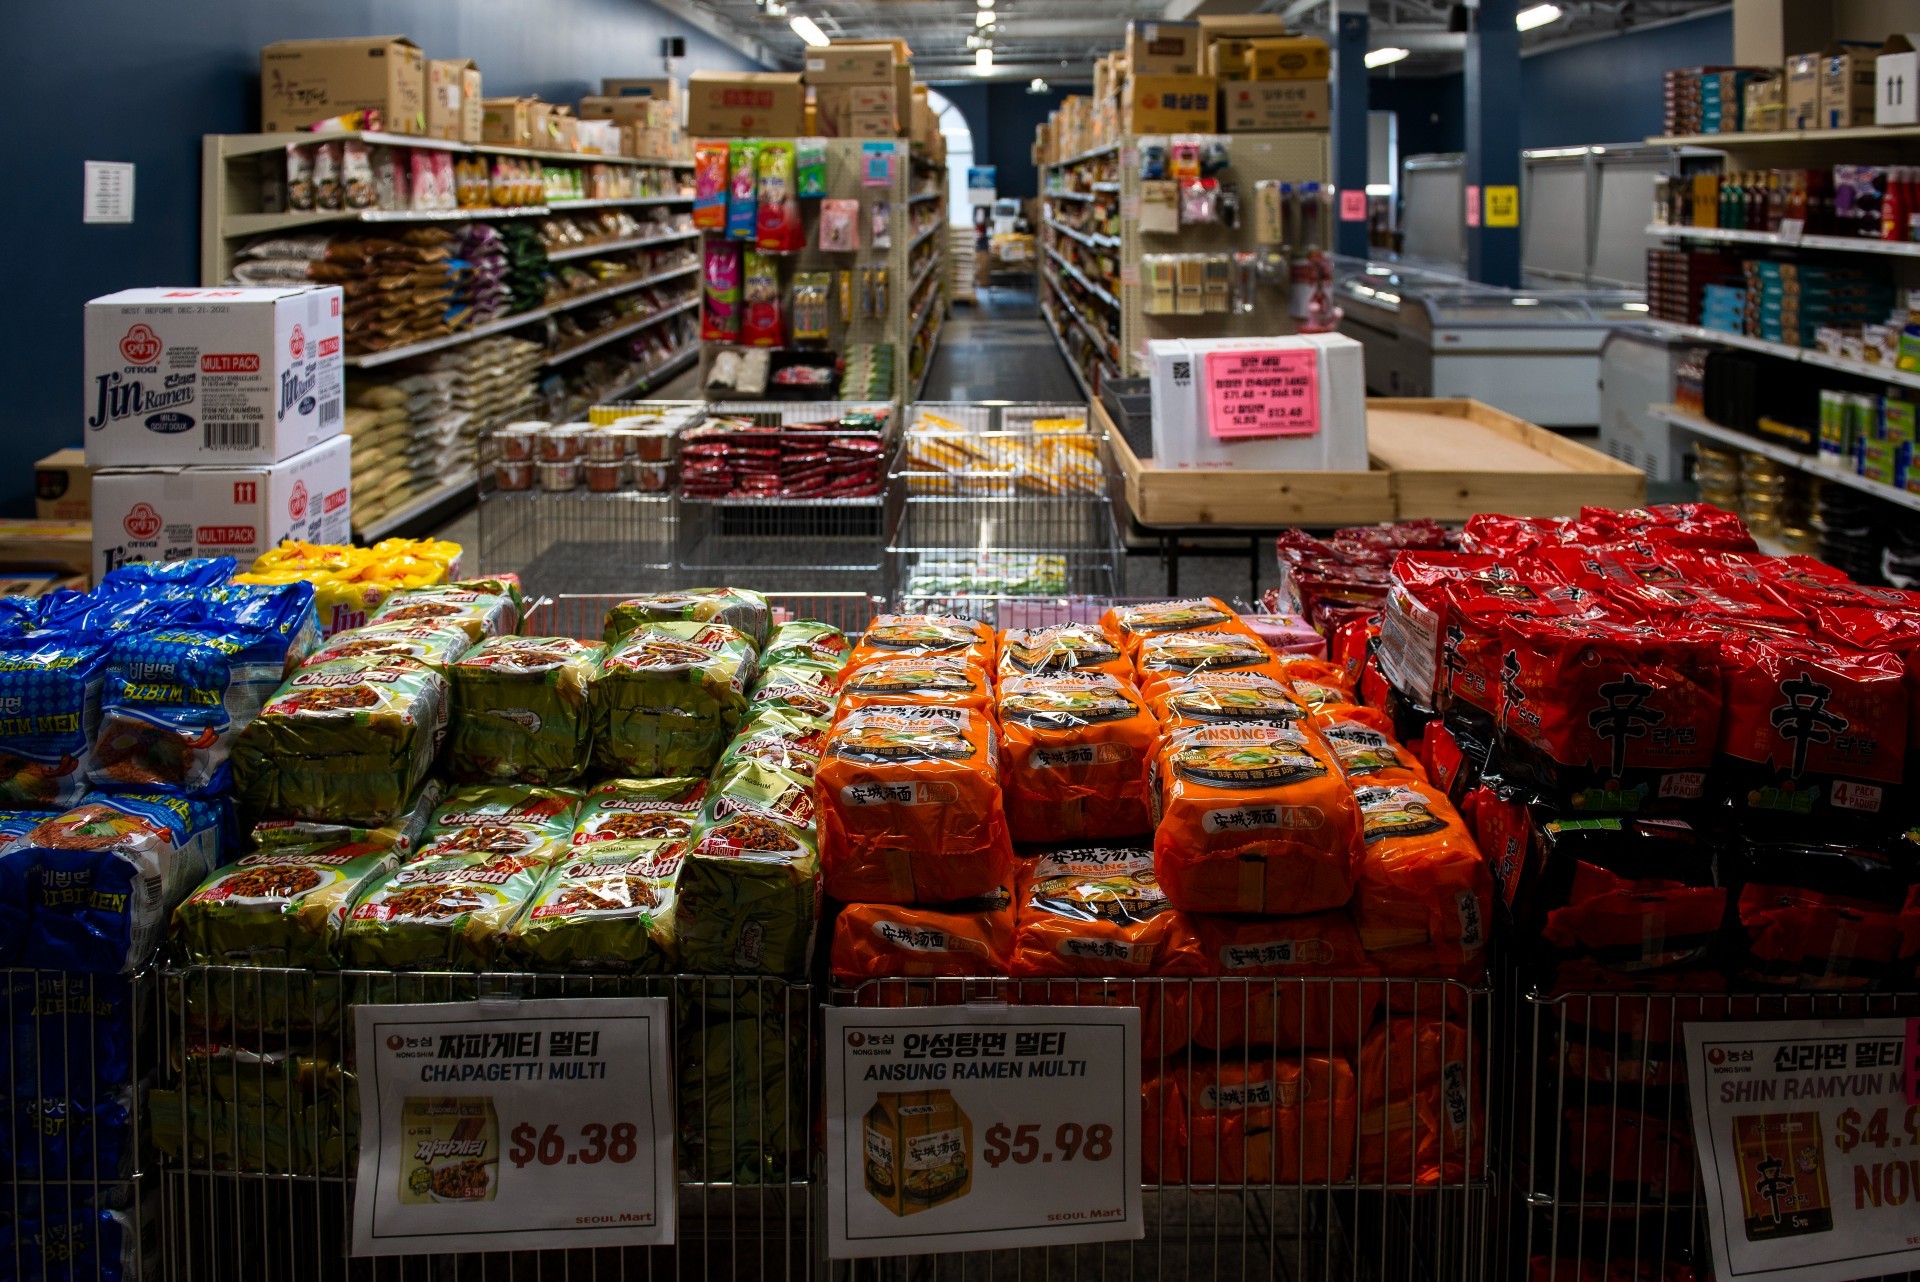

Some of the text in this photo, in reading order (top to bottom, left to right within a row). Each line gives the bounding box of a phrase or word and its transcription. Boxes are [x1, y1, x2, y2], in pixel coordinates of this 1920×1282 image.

[121, 306, 140, 315] BEST
[145, 306, 174, 314] BEFORE
[124, 366, 157, 374] OTTOGI
[202, 356, 230, 370] MULTI
[232, 356, 258, 370] PACK
[88, 371, 143, 430] Jin
[144, 387, 193, 411] Ramen
[278, 366, 298, 421] Jin
[198, 529, 226, 543] MULTI
[229, 529, 255, 542] PACK
[129, 662, 177, 681] 비빔면
[123, 682, 184, 703] BIBIM
[37, 711, 80, 733] MEN
[862, 715, 932, 726] ANSUNG
[1588, 672, 1667, 779] 辛
[1770, 671, 1850, 780] 辛
[1195, 728, 1266, 741] ANSUNG
[1651, 726, 1697, 746] 라면
[1833, 736, 1877, 756] 라면
[918, 784, 929, 802] 4
[1661, 774, 1702, 795] 4 PACK
[1834, 783, 1875, 806] 4 PACK
[1848, 796, 1878, 810] PAQUET
[599, 799, 702, 813] Chapagetti
[438, 812, 549, 826] Chapagetti
[1284, 808, 1295, 827] 4
[576, 833, 587, 845] 4
[236, 853, 354, 867] Chapagetti
[709, 846, 737, 857] PAQUET
[394, 866, 513, 885] Chapagetti
[562, 858, 680, 879] Chapagetti
[1057, 863, 1129, 872] ANSUNG
[1029, 883, 1041, 893] 4
[355, 905, 368, 920] 4
[534, 906, 547, 917] 4
[406, 1030, 600, 1059] 농심 짜파게티 멀티
[867, 1031, 1067, 1059] 농심 안성탕면 멀티
[1727, 1041, 1904, 1072] 농심 신라면 멀티
[420, 1060, 606, 1082] CHAPAGETTI MULTI
[863, 1059, 1087, 1082] ANSUNG RAMEN MULTI
[1719, 1078, 1777, 1104] SHIN
[1783, 1072, 1884, 1100] RAMYUN
[415, 1139, 488, 1165] 짜파게티
[508, 1121, 638, 1169] $6.38
[983, 1121, 1114, 1169] $5.98
[1755, 1153, 1796, 1225] 辛
[575, 1212, 653, 1224] SEOUL Mart
[1047, 1207, 1123, 1222] SEOUL Mart
